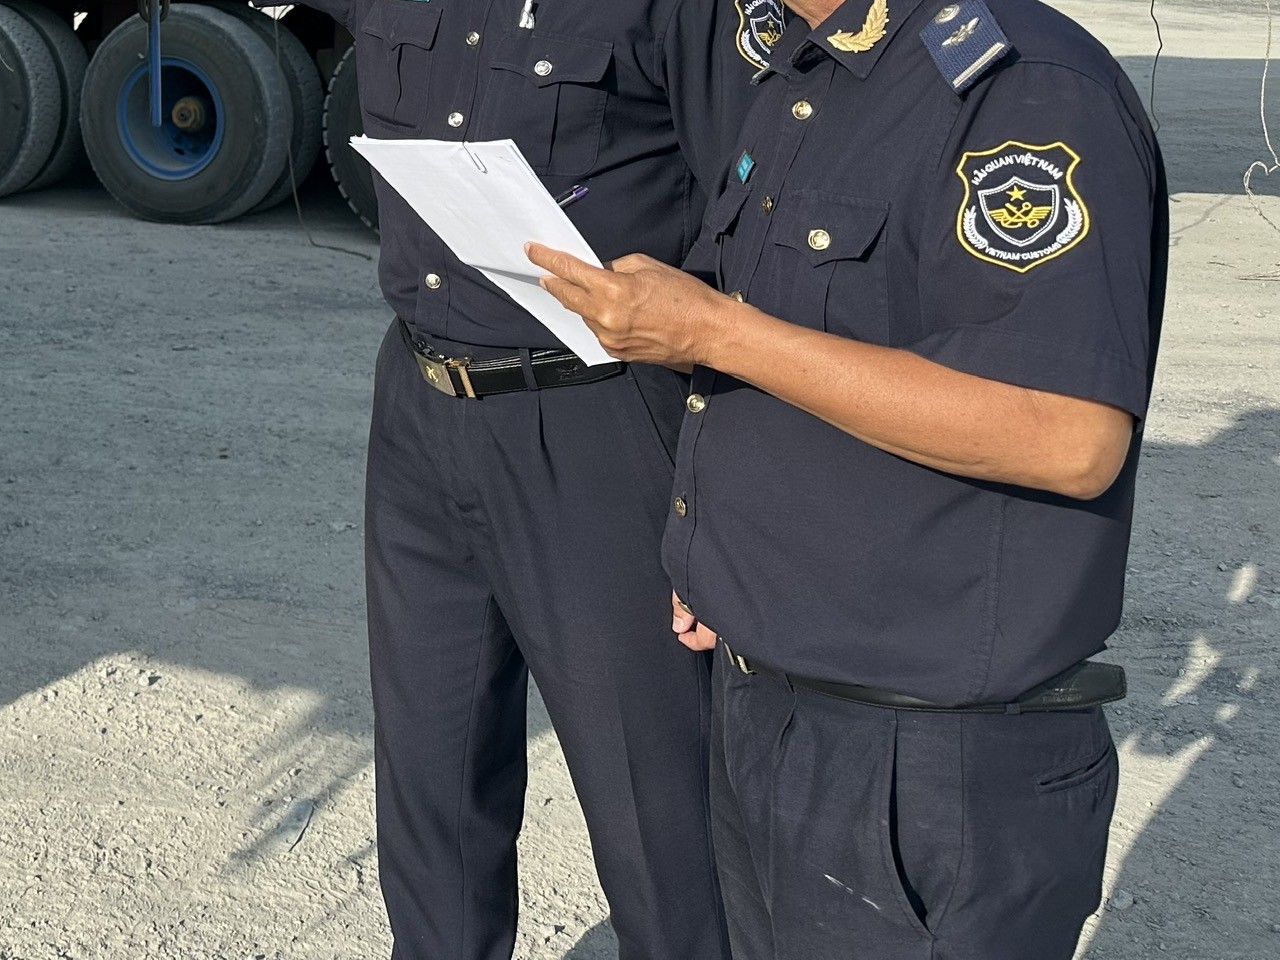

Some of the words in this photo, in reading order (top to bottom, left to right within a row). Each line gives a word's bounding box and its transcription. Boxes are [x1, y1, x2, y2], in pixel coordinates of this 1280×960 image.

[985, 154, 1015, 173] QUAN
[1013, 152, 1039, 166] VIỆT
[1038, 159, 1064, 180] NAM
[984, 245, 1020, 260] VIETNAM
[1021, 242, 1062, 260] CUSTOMS
